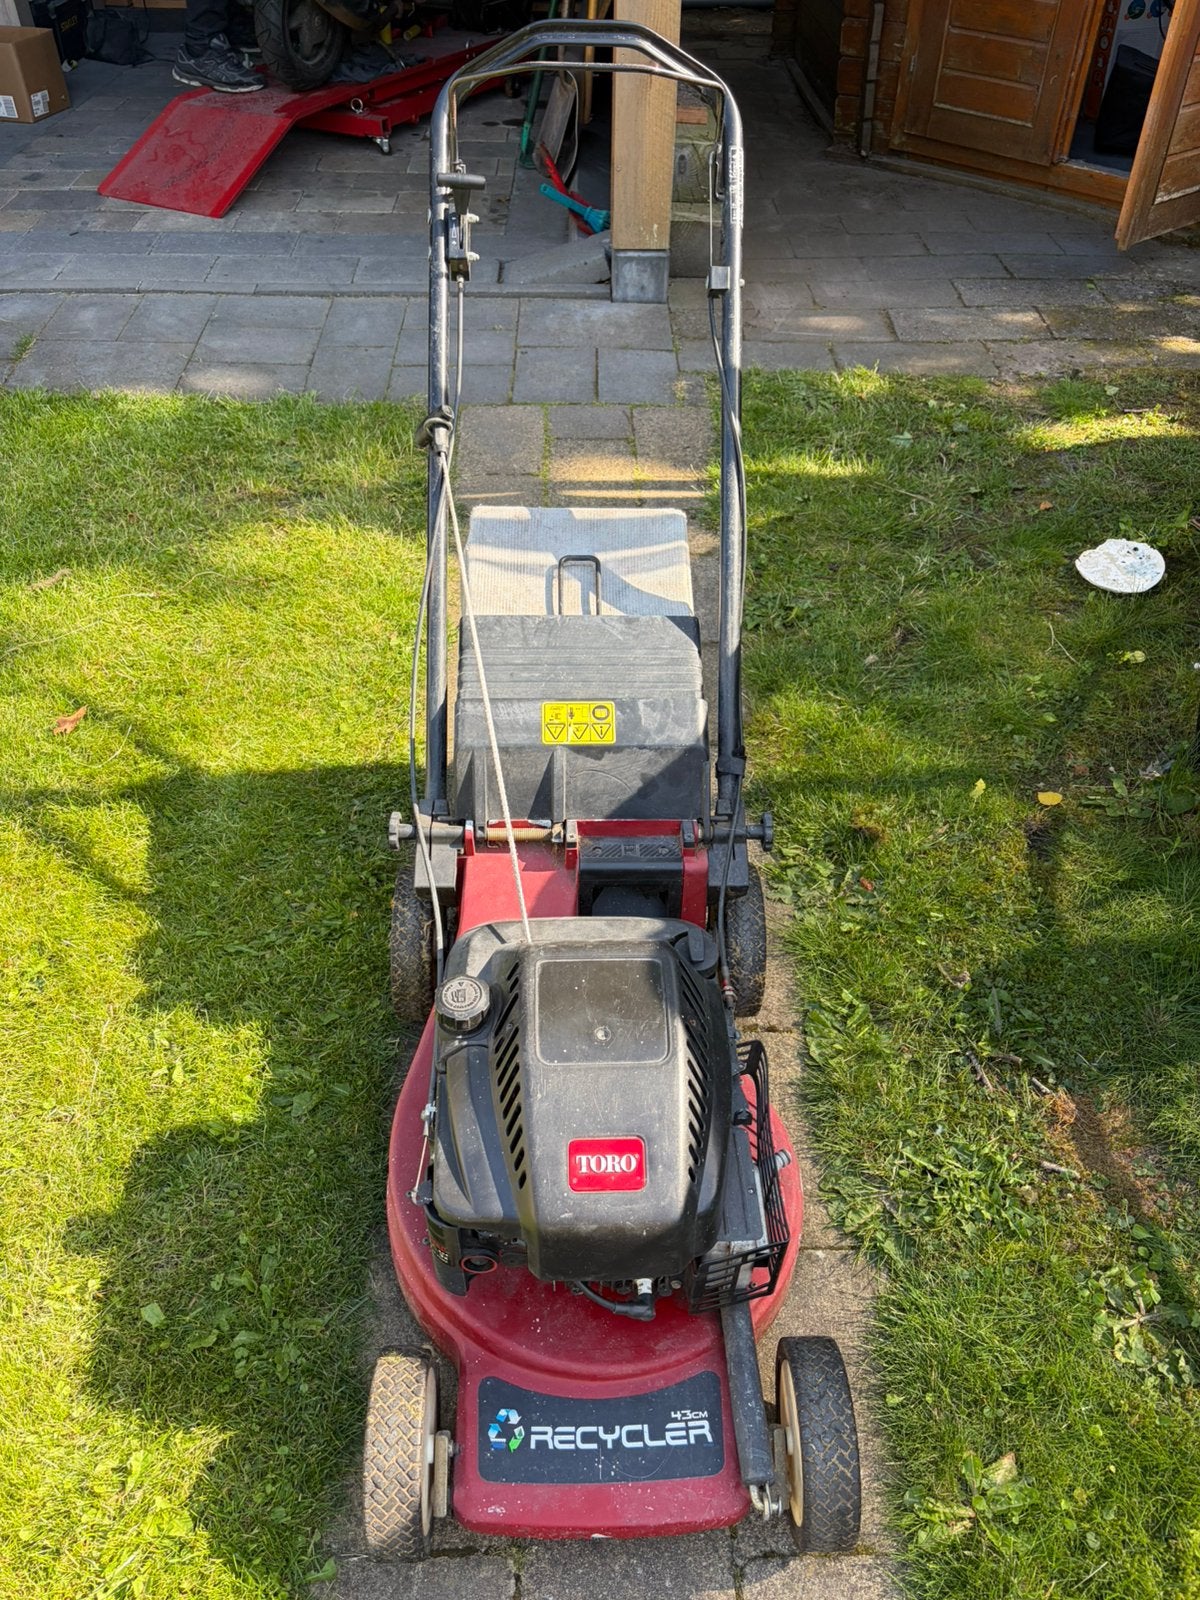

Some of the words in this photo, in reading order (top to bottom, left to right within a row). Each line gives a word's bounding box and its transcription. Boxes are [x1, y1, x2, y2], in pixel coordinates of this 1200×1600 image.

[575, 1153, 637, 1173] TORO
[671, 1409, 709, 1421] 43CM
[530, 1420, 713, 1450] RECYCLER
